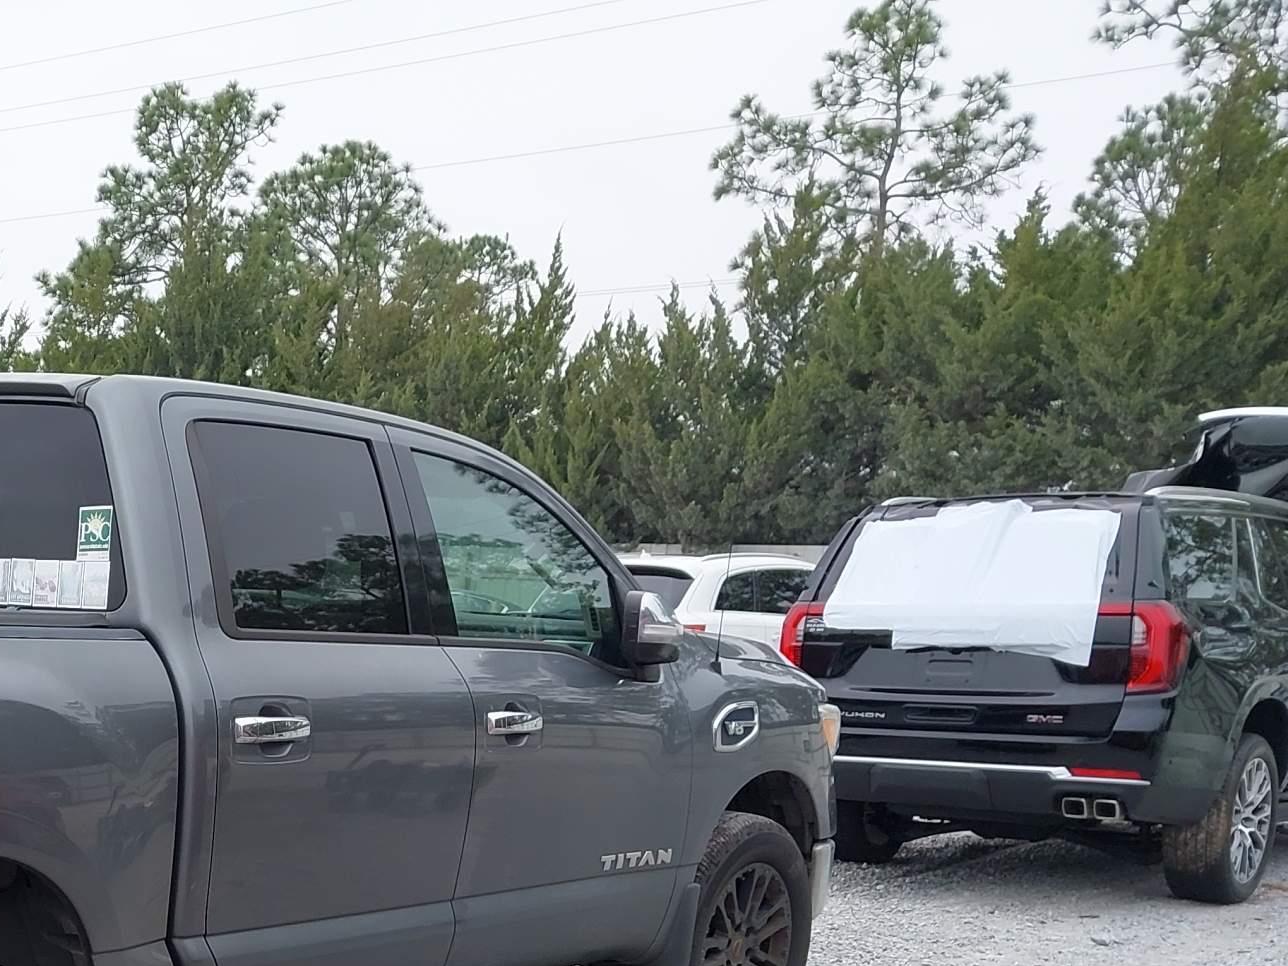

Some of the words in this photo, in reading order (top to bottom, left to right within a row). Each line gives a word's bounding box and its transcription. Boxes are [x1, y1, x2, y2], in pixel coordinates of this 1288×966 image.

[80, 521, 111, 542] PSC
[1026, 714, 1064, 724] GMC
[600, 848, 673, 871] TITAN
